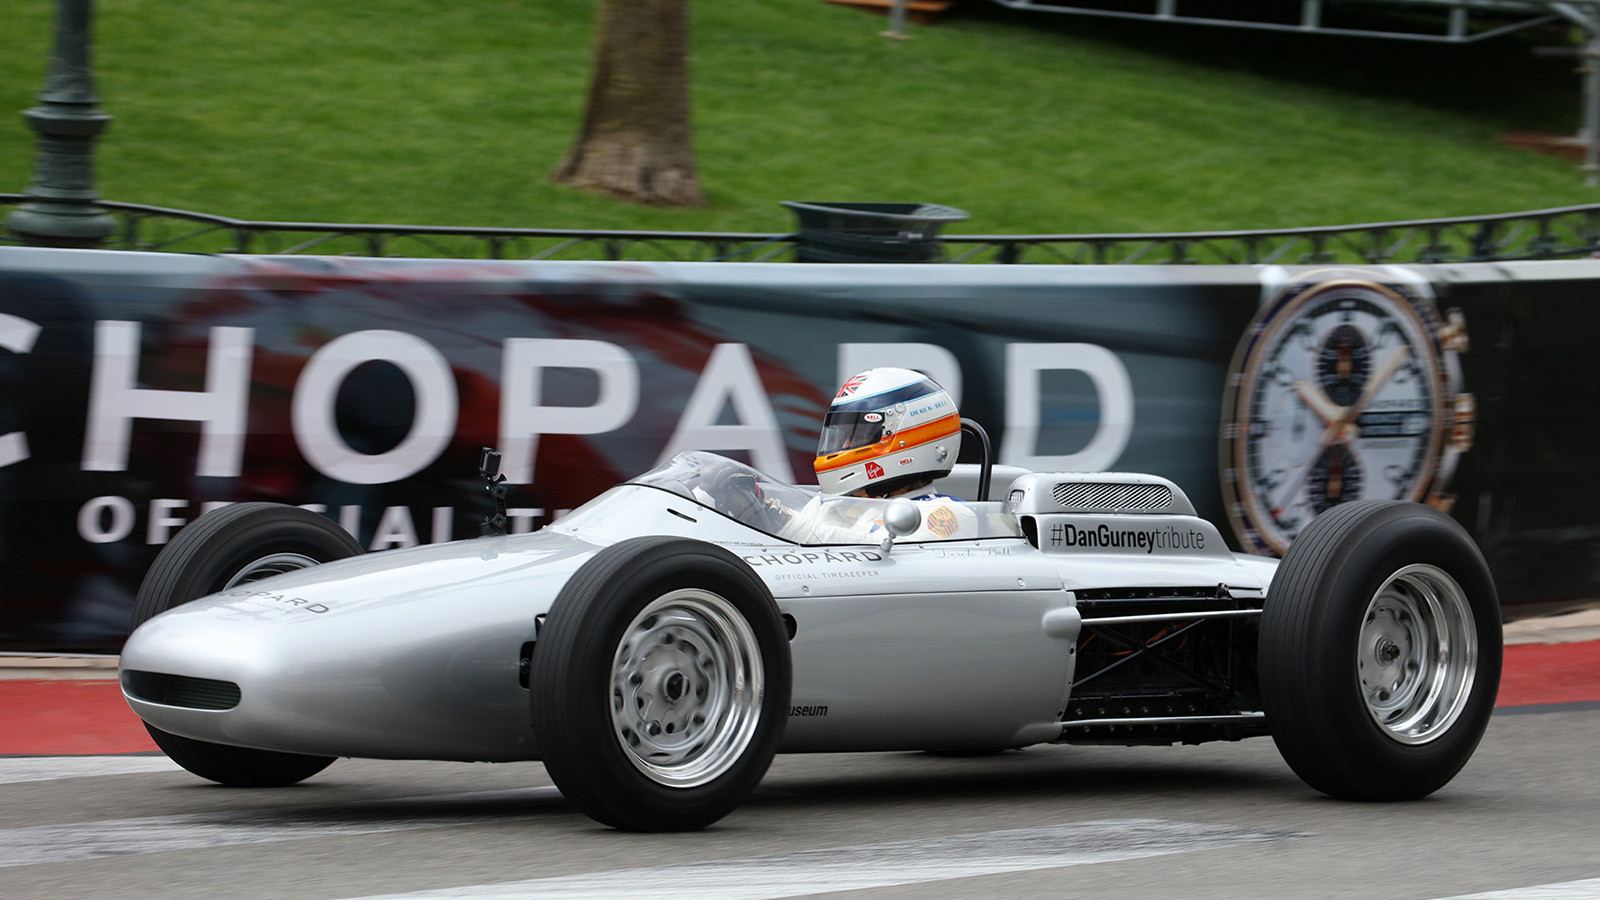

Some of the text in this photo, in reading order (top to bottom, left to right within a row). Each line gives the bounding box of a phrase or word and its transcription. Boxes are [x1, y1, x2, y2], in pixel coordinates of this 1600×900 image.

[910, 406, 933, 416] DEREK
[899, 457, 914, 465] BELL
[1050, 524, 1205, 554] #DanGurneytribute
[743, 551, 882, 567] CHOPARD
[775, 570, 880, 581] OFFICIAL TIMEKEEPER
[787, 705, 828, 717] useum
